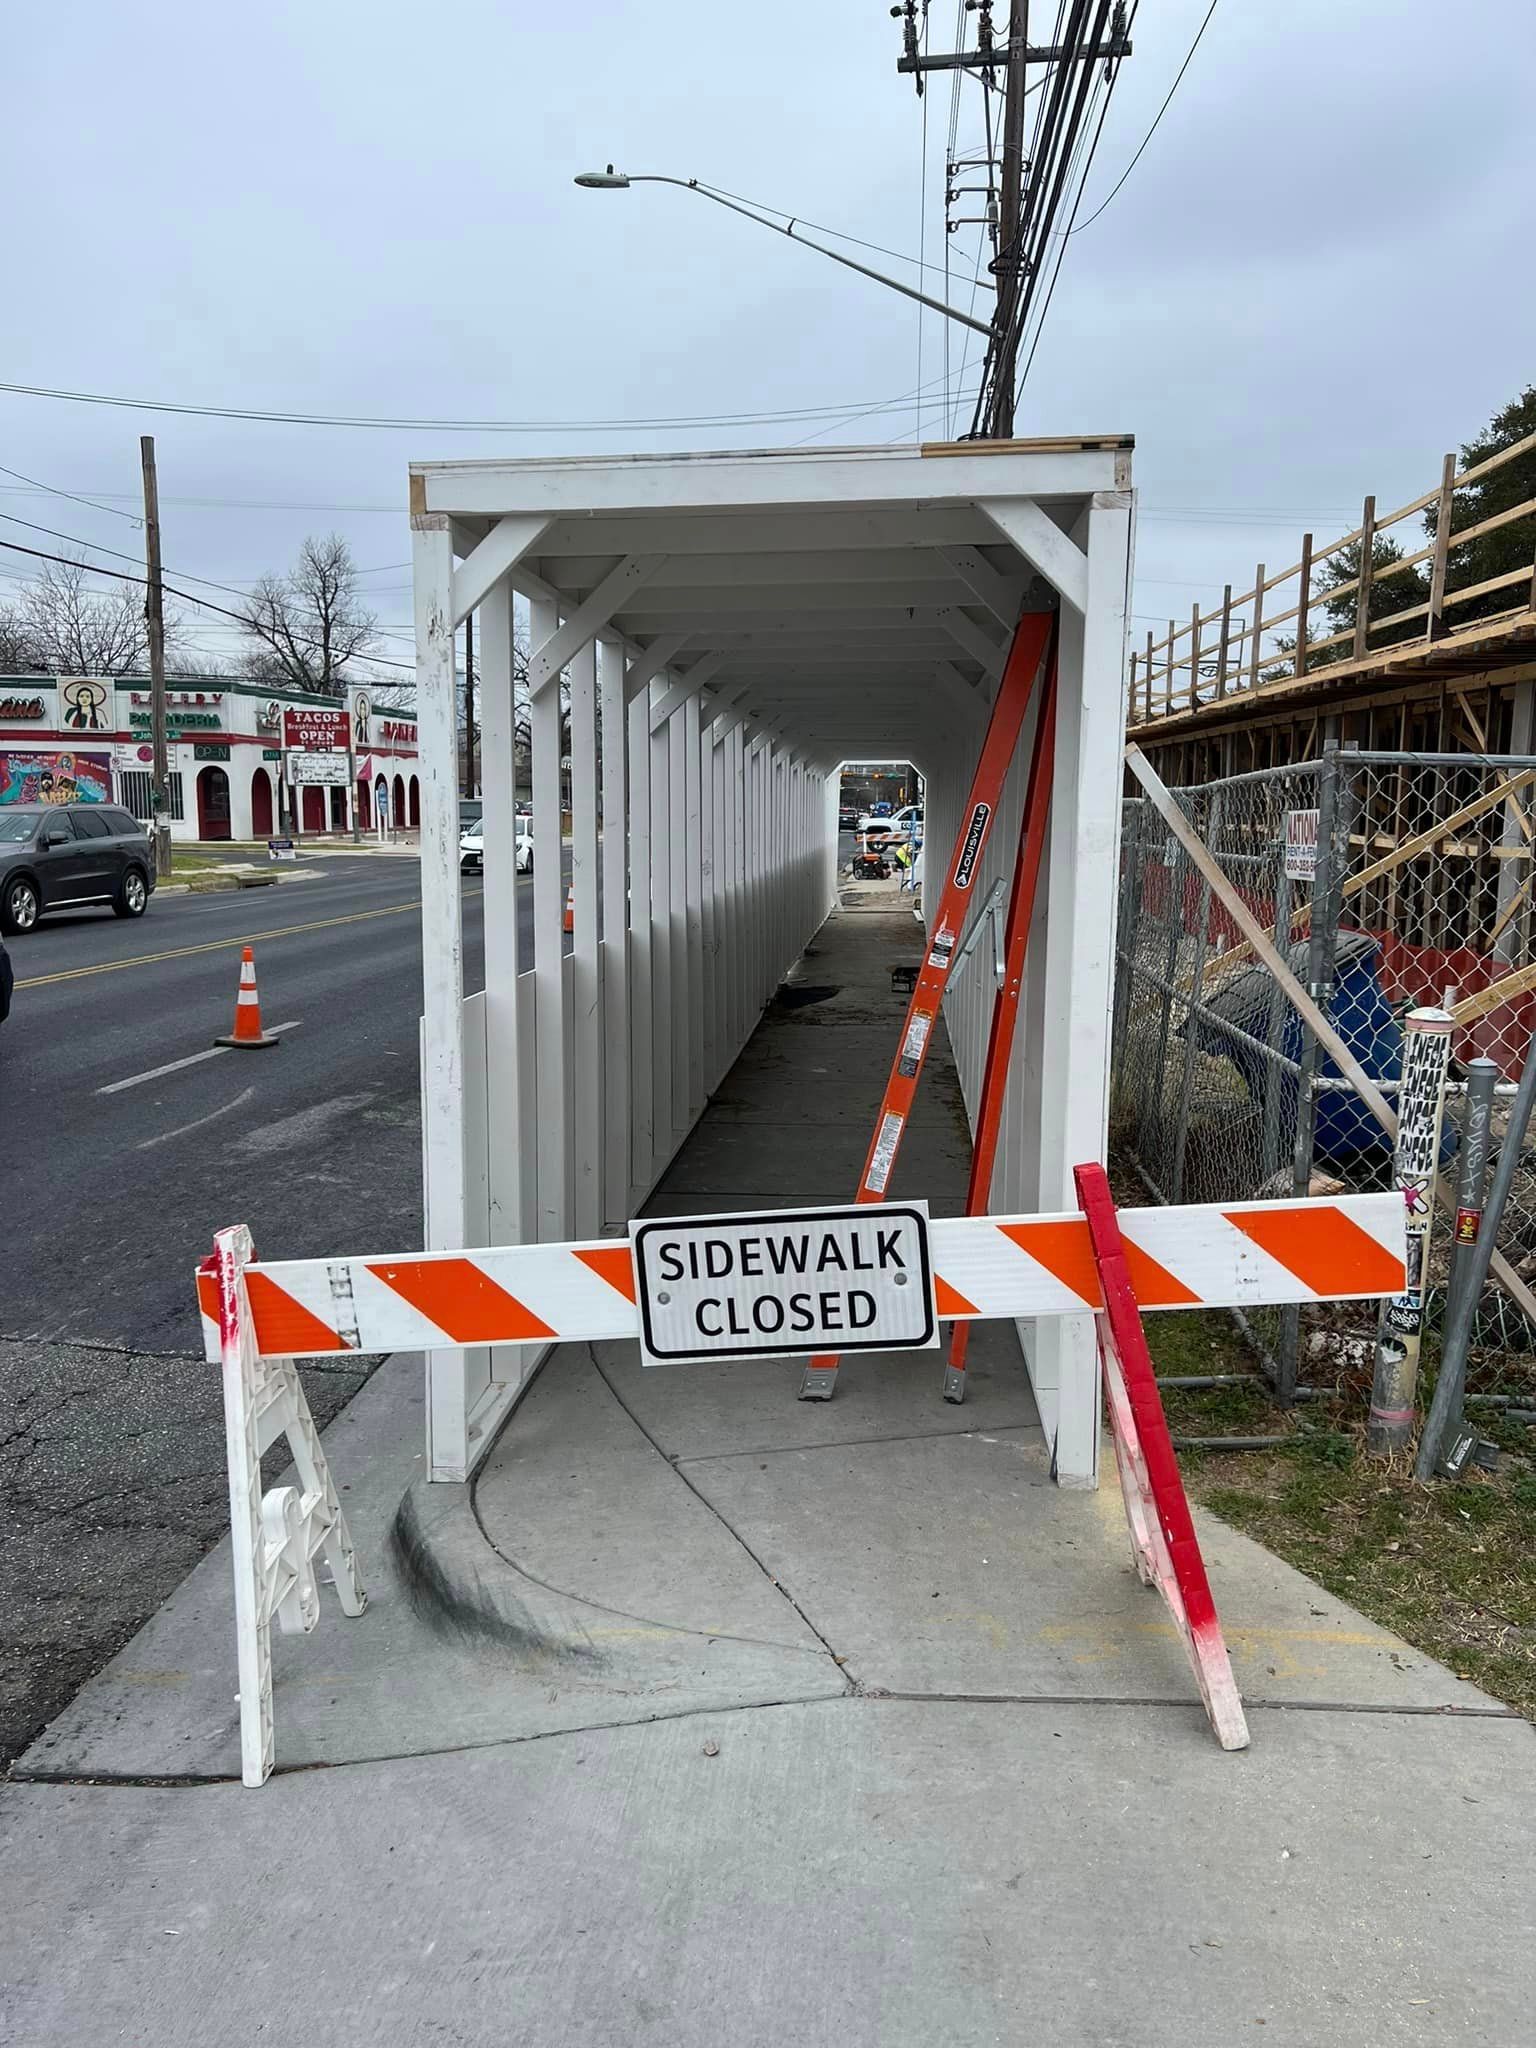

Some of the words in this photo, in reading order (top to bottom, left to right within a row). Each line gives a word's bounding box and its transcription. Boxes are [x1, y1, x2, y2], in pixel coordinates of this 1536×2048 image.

[294, 712, 340, 723] TACOS
[195, 745, 227, 759] OPEN
[299, 730, 336, 741] OPEN
[961, 805, 987, 874] LOUISVILLE
[1287, 812, 1318, 845] NATIONA
[659, 1230, 906, 1281] SIDEWALK
[695, 1290, 877, 1336] CLOSED
